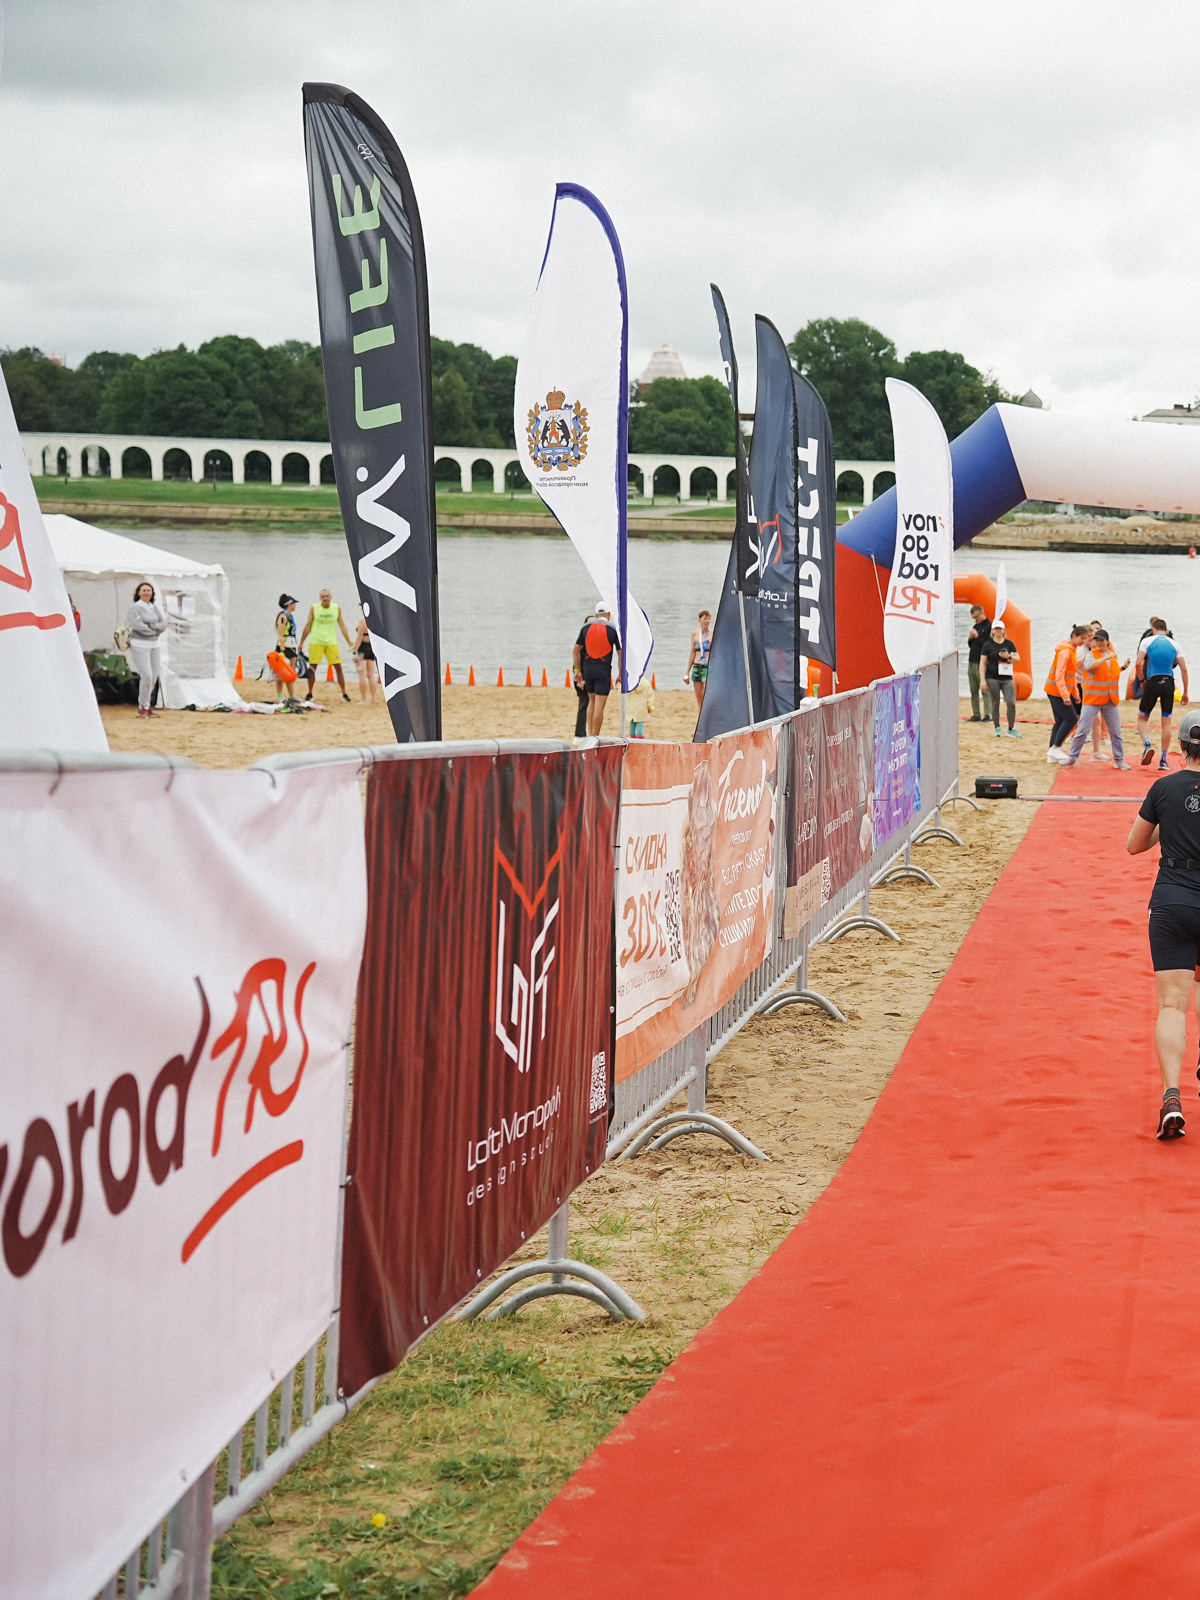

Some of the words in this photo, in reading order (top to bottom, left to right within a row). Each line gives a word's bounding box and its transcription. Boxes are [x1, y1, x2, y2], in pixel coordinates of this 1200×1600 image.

[625, 832, 668, 878] СКИДКА
[620, 889, 667, 968] 30%
[466, 1161, 516, 1206] design
